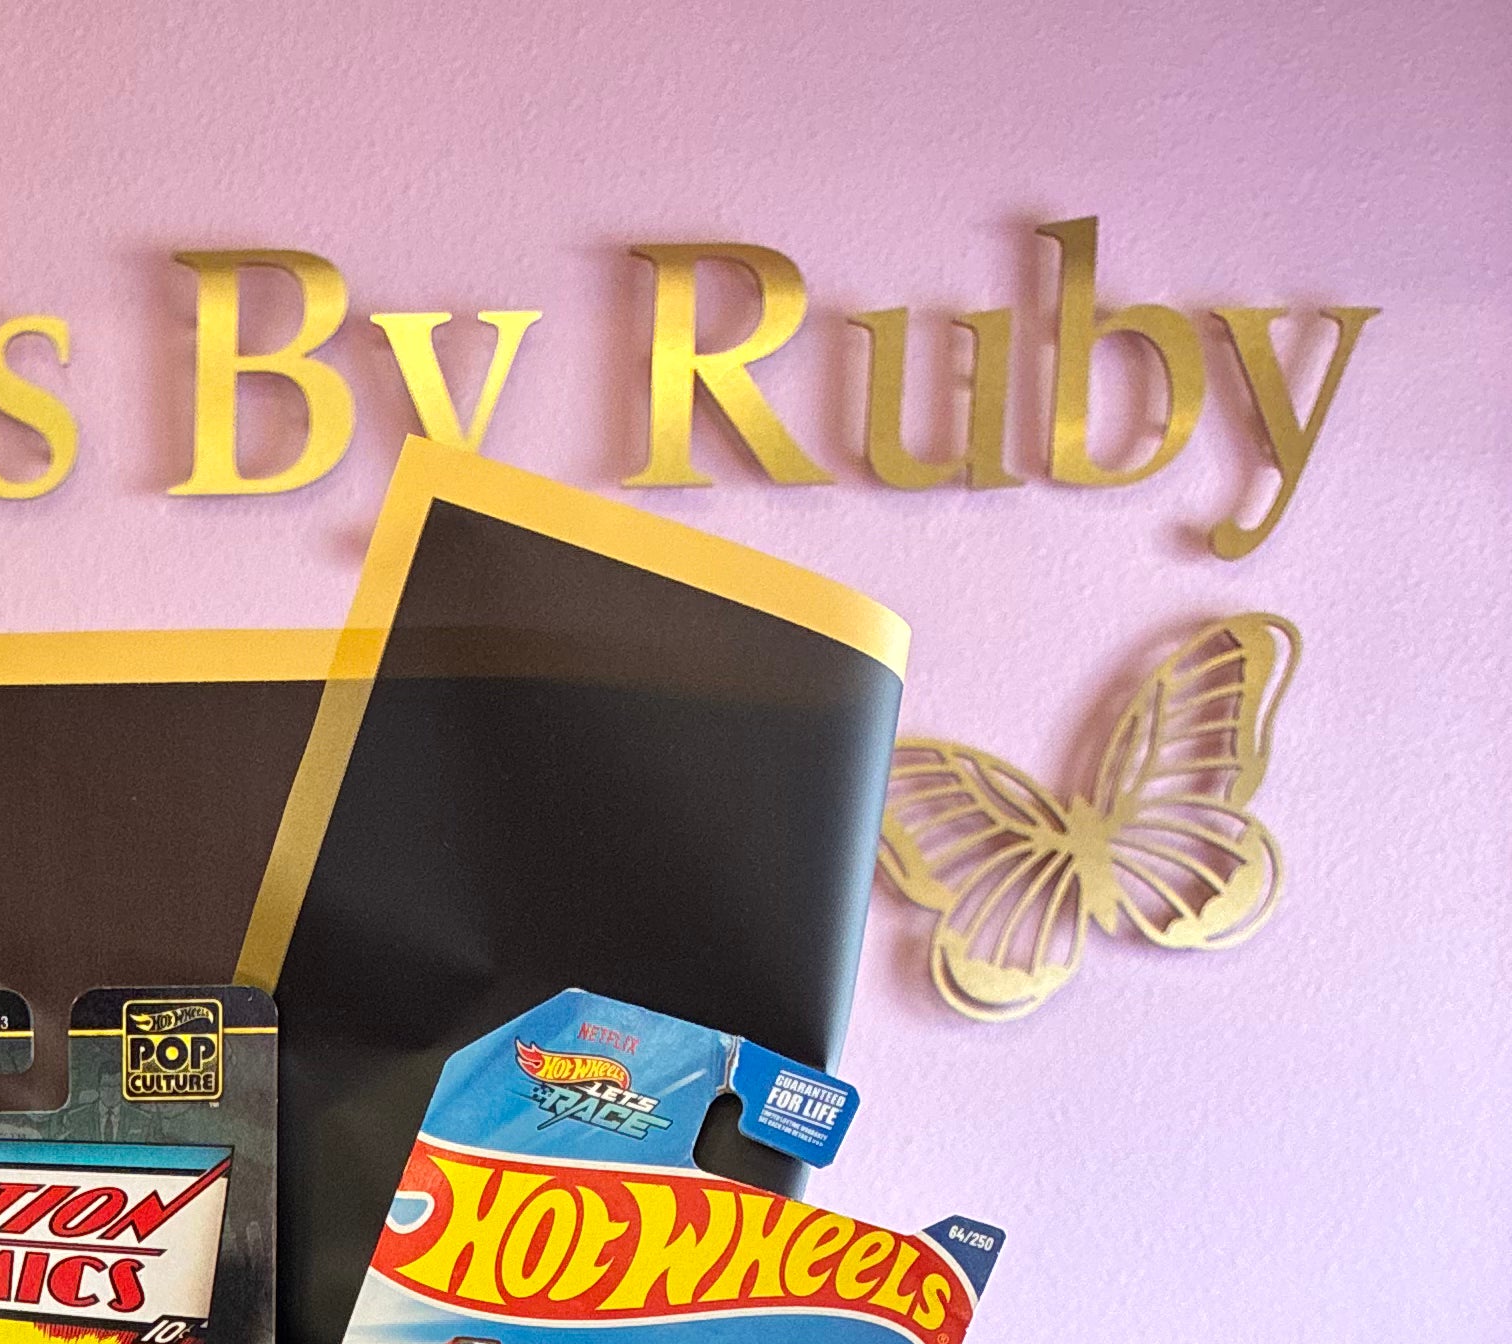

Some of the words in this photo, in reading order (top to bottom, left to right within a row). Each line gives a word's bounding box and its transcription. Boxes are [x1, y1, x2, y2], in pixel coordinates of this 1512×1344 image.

[622, 216, 1383, 561] Ruby
[129, 1036, 217, 1072] POP
[577, 1022, 640, 1055] NETFLIX
[129, 1073, 215, 1093] CULTURE
[584, 1082, 659, 1113] LET'S
[775, 1075, 847, 1107] GUARANTEED
[538, 1085, 673, 1140] RACE
[767, 1086, 804, 1113] FOR
[802, 1099, 839, 1126] LIFE
[948, 1224, 995, 1251] 64/250
